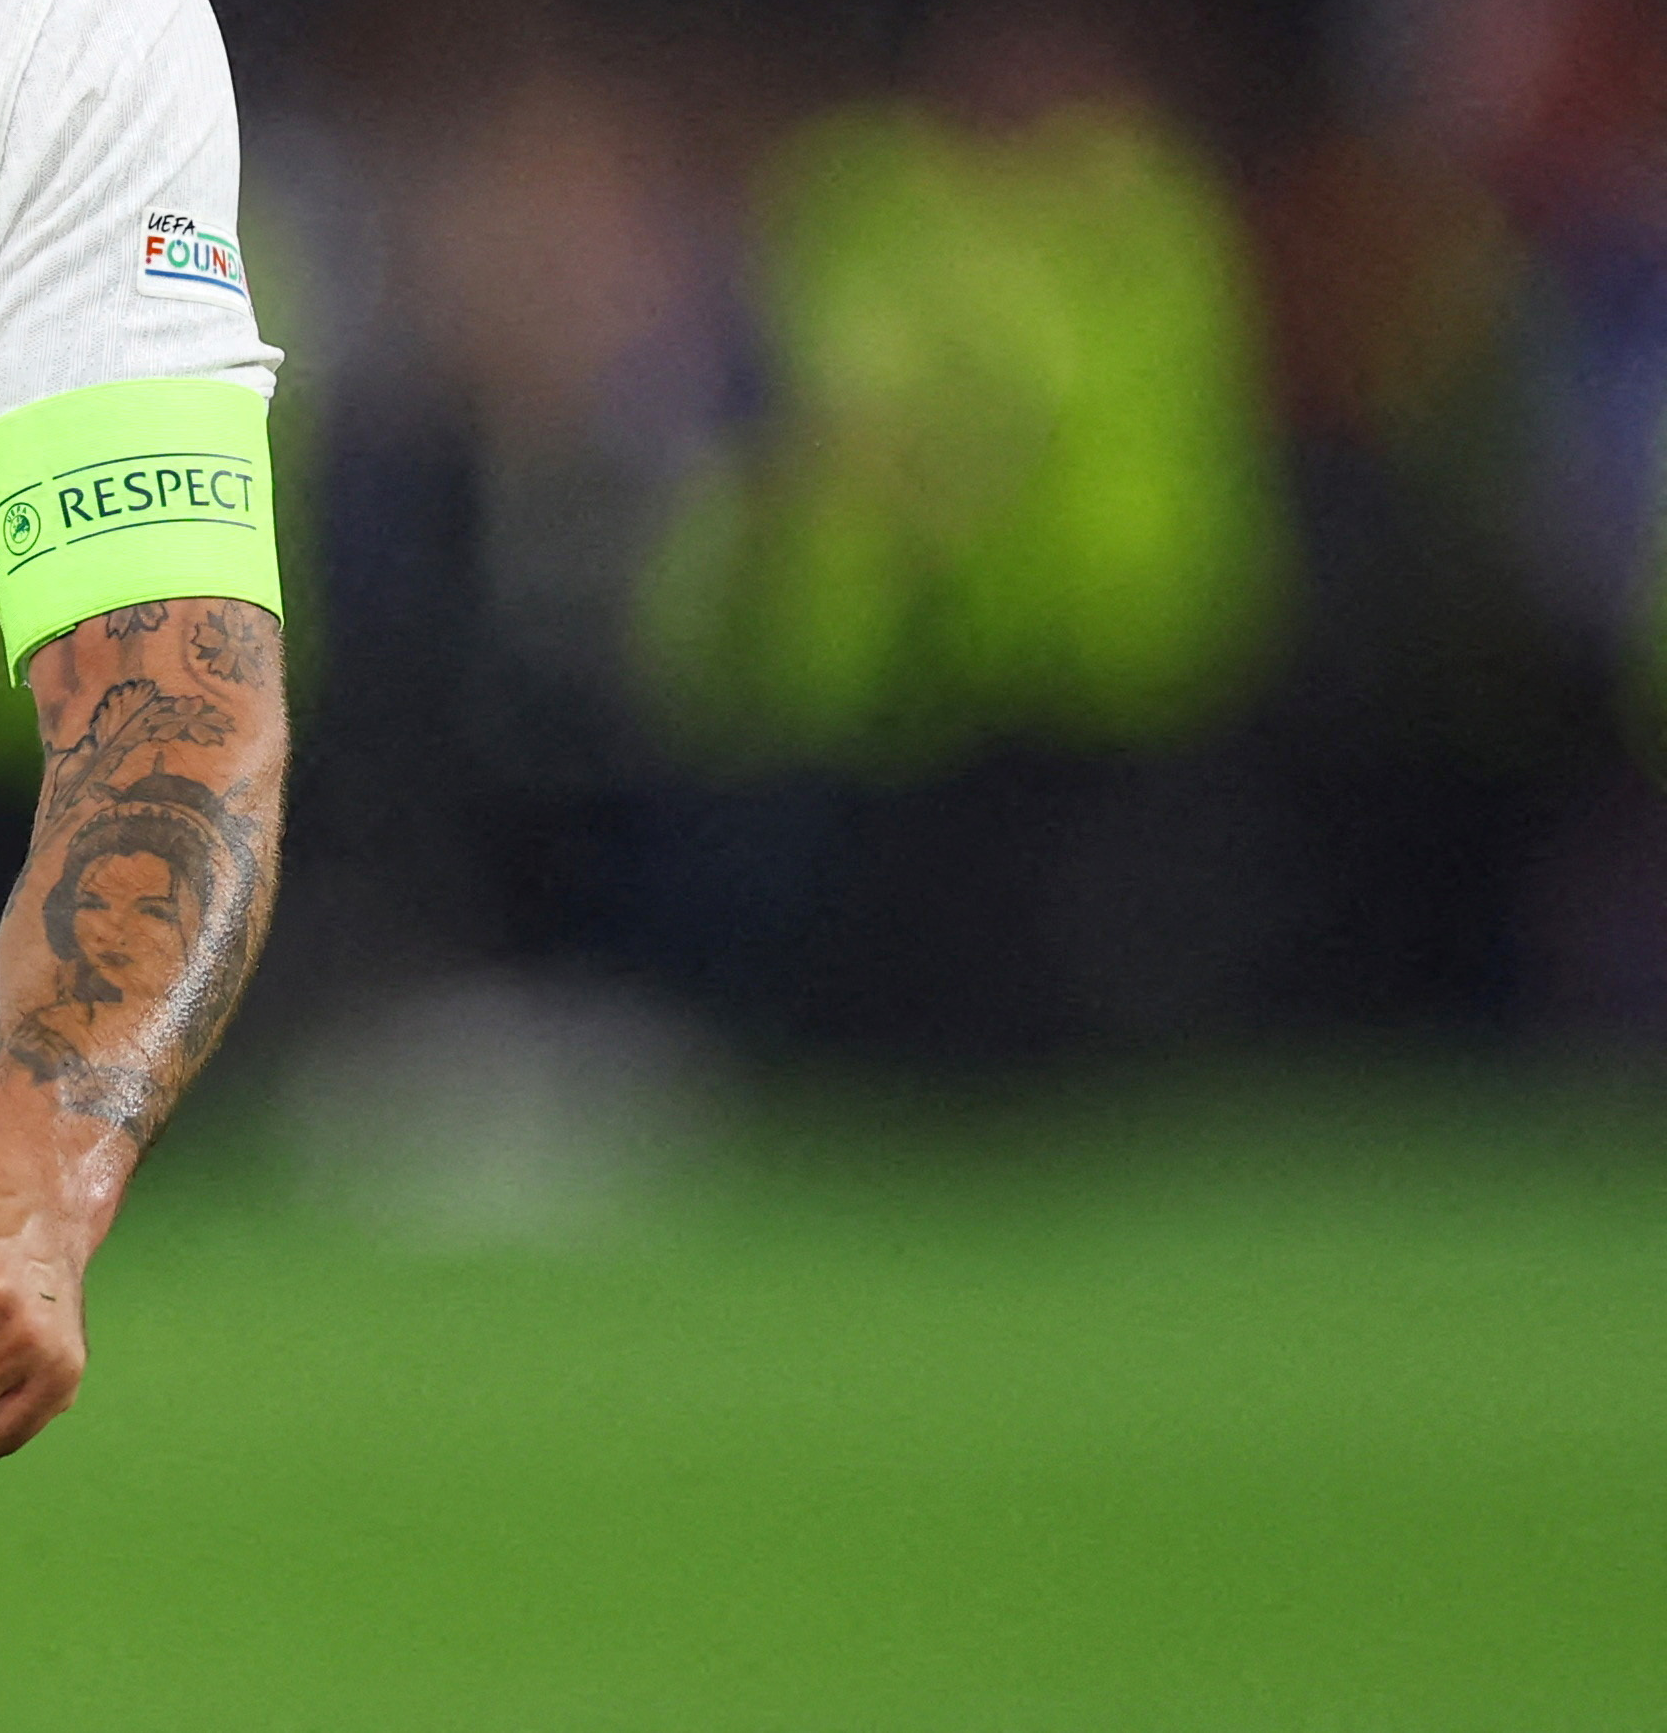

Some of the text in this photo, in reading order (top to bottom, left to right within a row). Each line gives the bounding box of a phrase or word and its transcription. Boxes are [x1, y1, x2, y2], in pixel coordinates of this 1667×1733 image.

[148, 212, 195, 235] UEFA
[145, 236, 244, 284] FOUND
[58, 470, 253, 527] RESPECT
